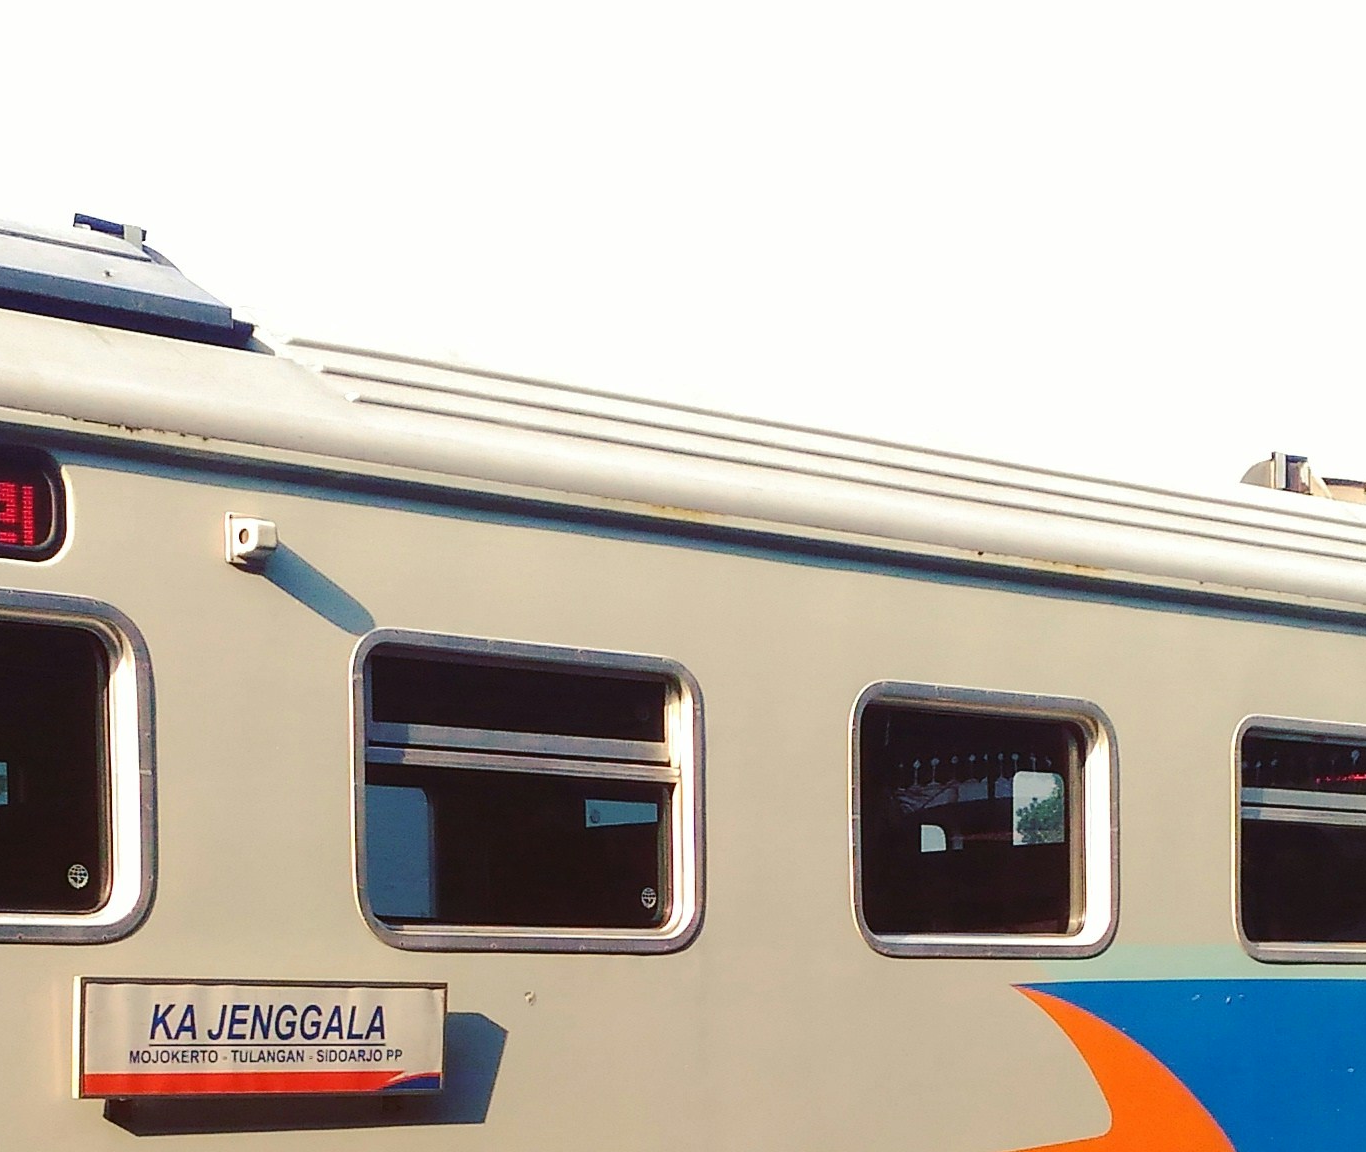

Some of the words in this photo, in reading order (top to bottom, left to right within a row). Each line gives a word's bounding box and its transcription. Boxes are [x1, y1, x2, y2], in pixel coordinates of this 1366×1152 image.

[149, 1004, 197, 1040] KA
[207, 1004, 386, 1041] JENGGALA
[129, 1050, 219, 1064] MOJOKERTO
[231, 1050, 305, 1063] TULANGAN
[316, 1049, 383, 1063] SIDOARJO
[386, 1049, 403, 1061] PP
